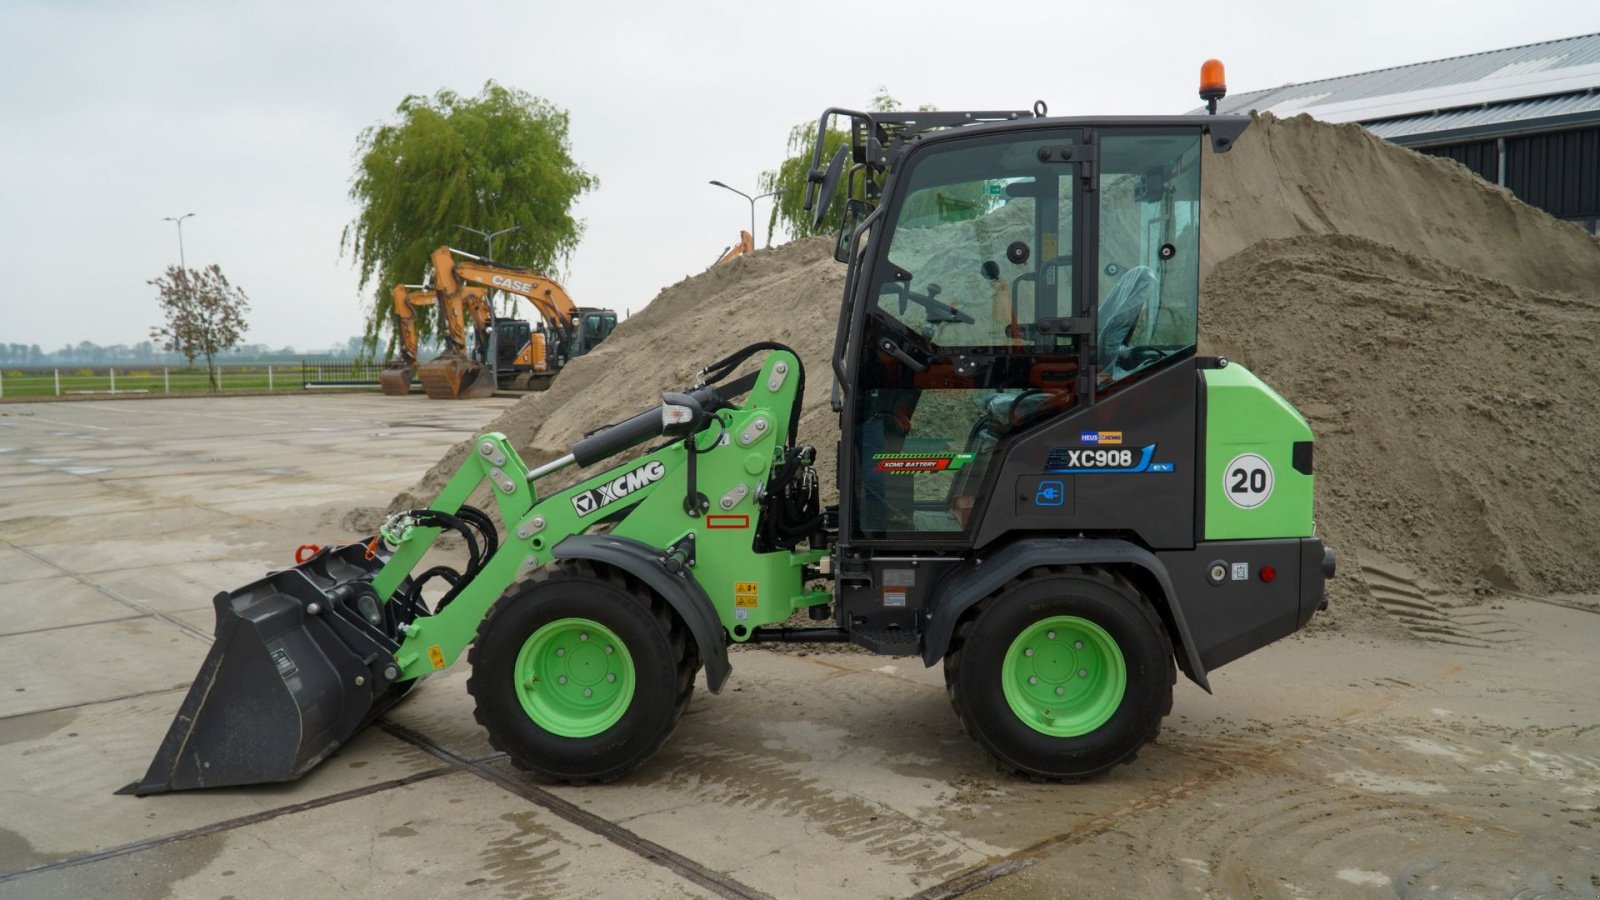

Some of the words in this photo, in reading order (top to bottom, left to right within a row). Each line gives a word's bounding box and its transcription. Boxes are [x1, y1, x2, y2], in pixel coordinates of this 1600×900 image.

[492, 274, 533, 293] CASE
[1068, 450, 1132, 467] XC908
[596, 460, 665, 508] XCMG
[1231, 468, 1266, 493] 20
